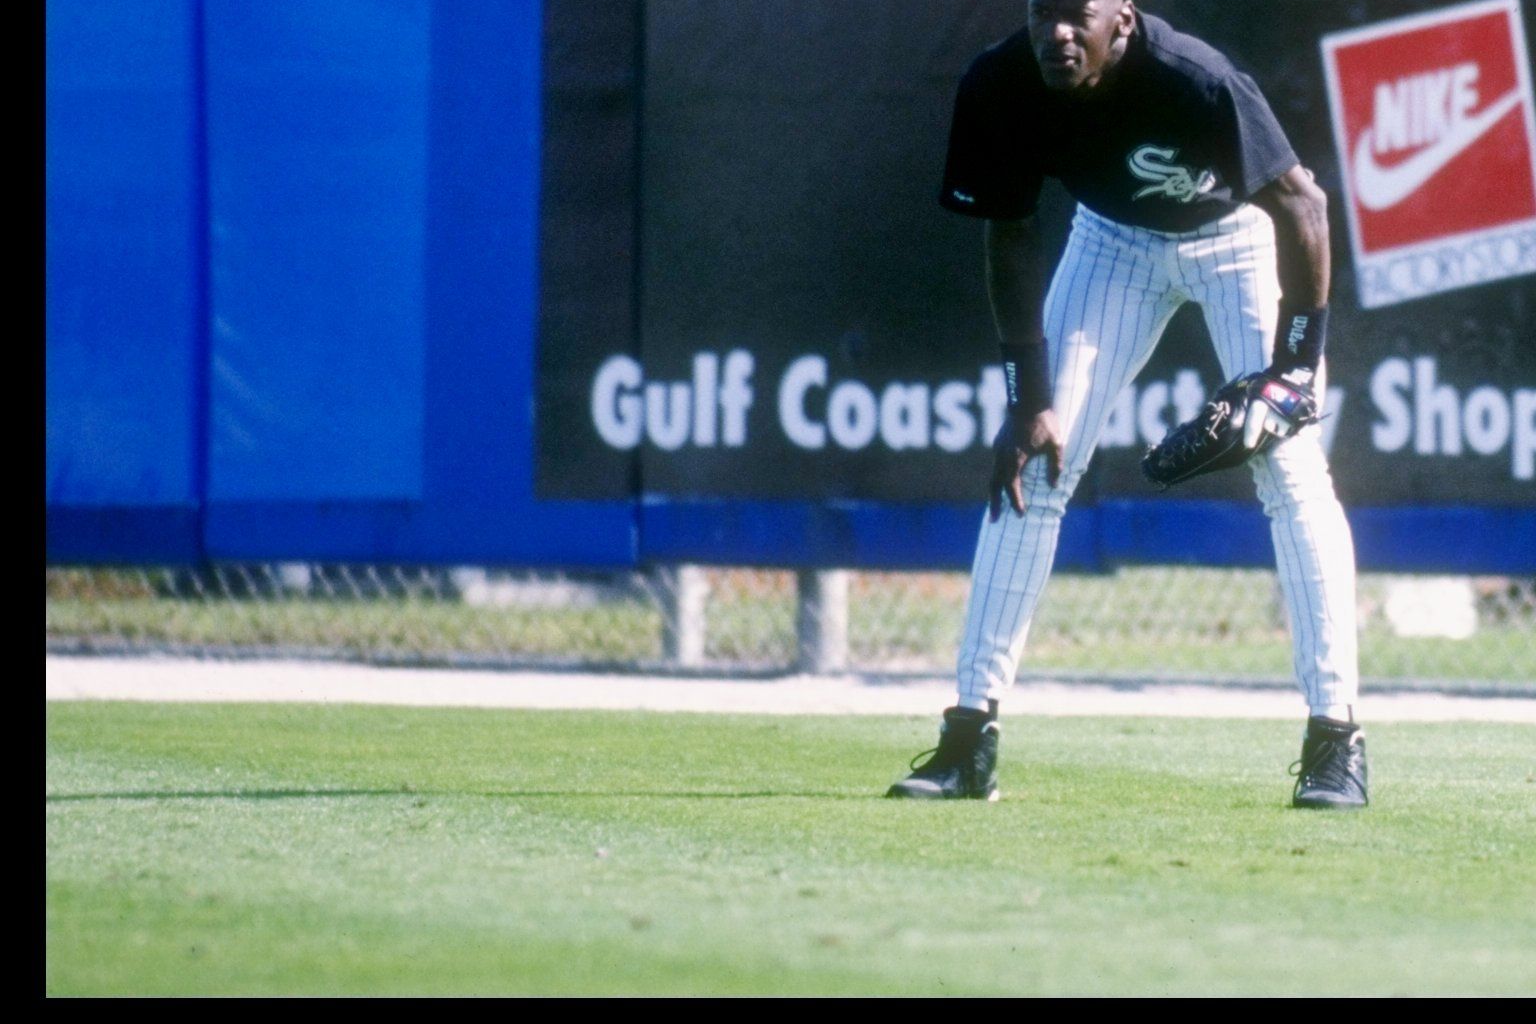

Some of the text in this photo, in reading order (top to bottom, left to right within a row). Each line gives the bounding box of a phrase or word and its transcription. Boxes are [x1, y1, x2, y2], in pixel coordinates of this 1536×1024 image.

[1371, 60, 1481, 154] NIKE
[592, 350, 754, 450] Gulf
[779, 357, 1006, 452] Coast
